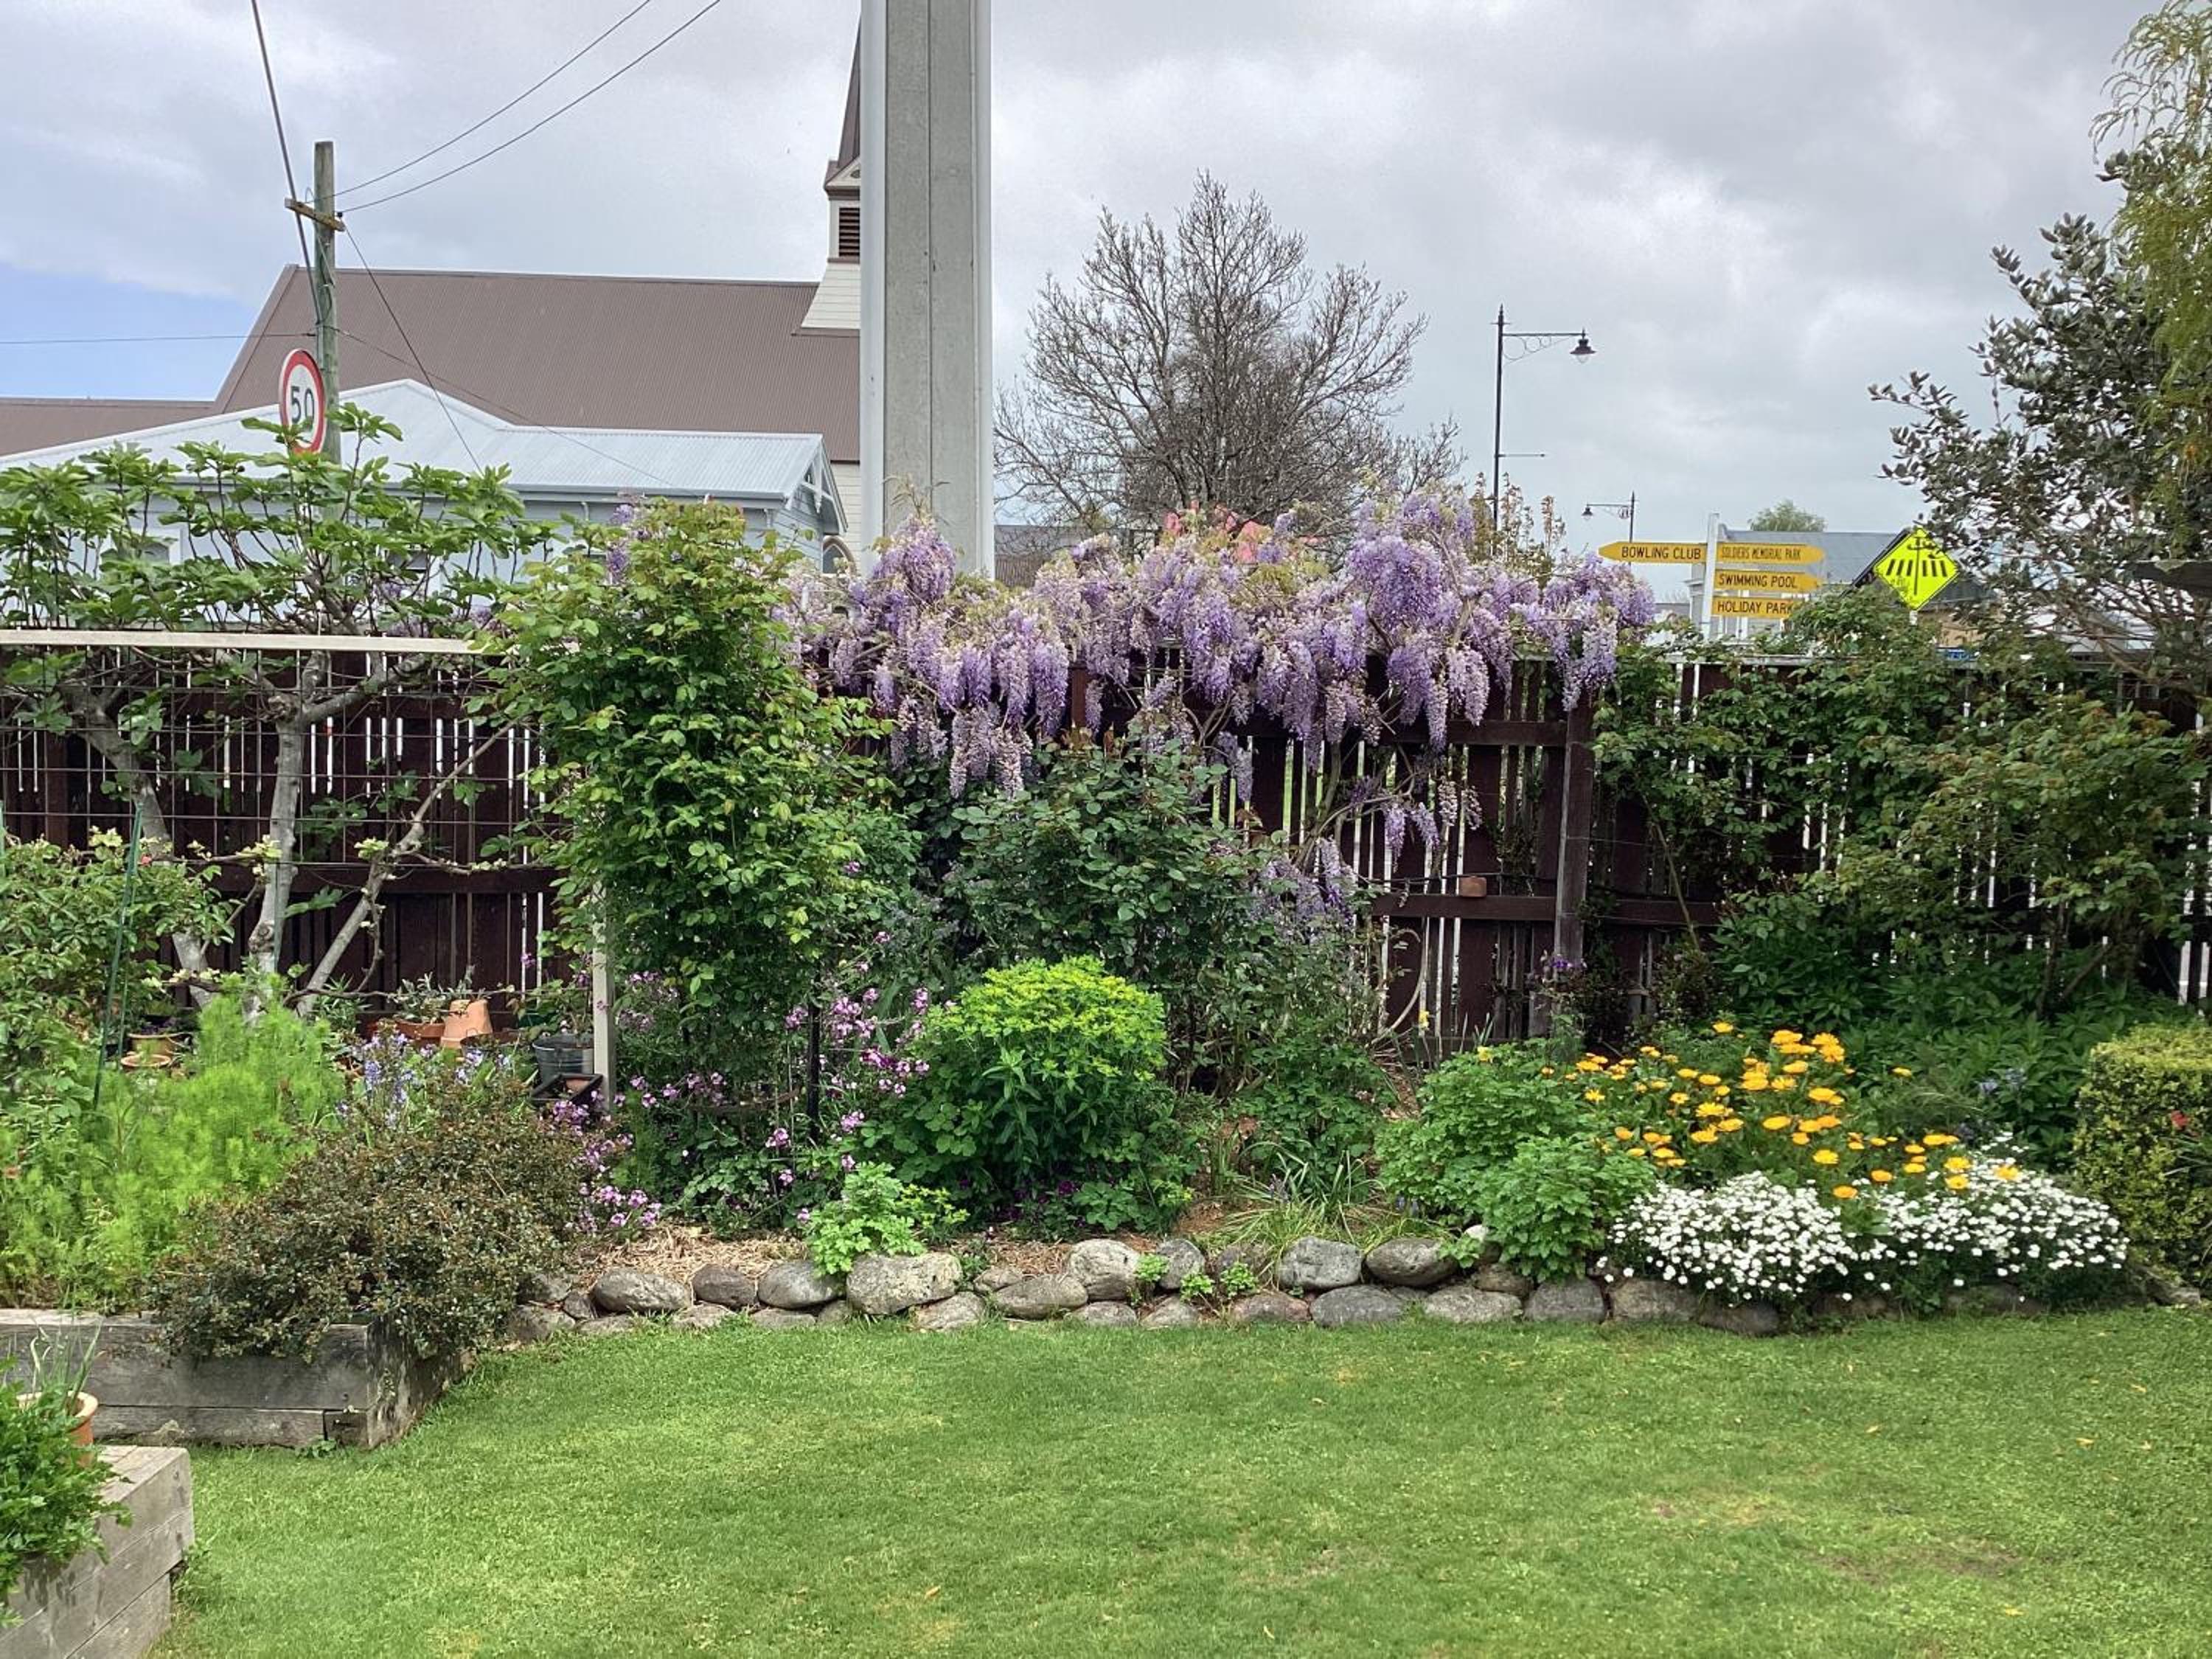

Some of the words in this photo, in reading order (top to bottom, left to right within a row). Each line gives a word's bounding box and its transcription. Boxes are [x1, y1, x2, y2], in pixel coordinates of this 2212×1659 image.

[291, 386, 315, 427] 50
[1621, 546, 1669, 559] BOWLING
[1673, 547, 1702, 560] CLUB
[1785, 548, 1801, 561] PARK
[1718, 574, 1767, 587] SWIMMING
[1771, 576, 1798, 588] POOL
[1717, 601, 1762, 613] HOLIDAY
